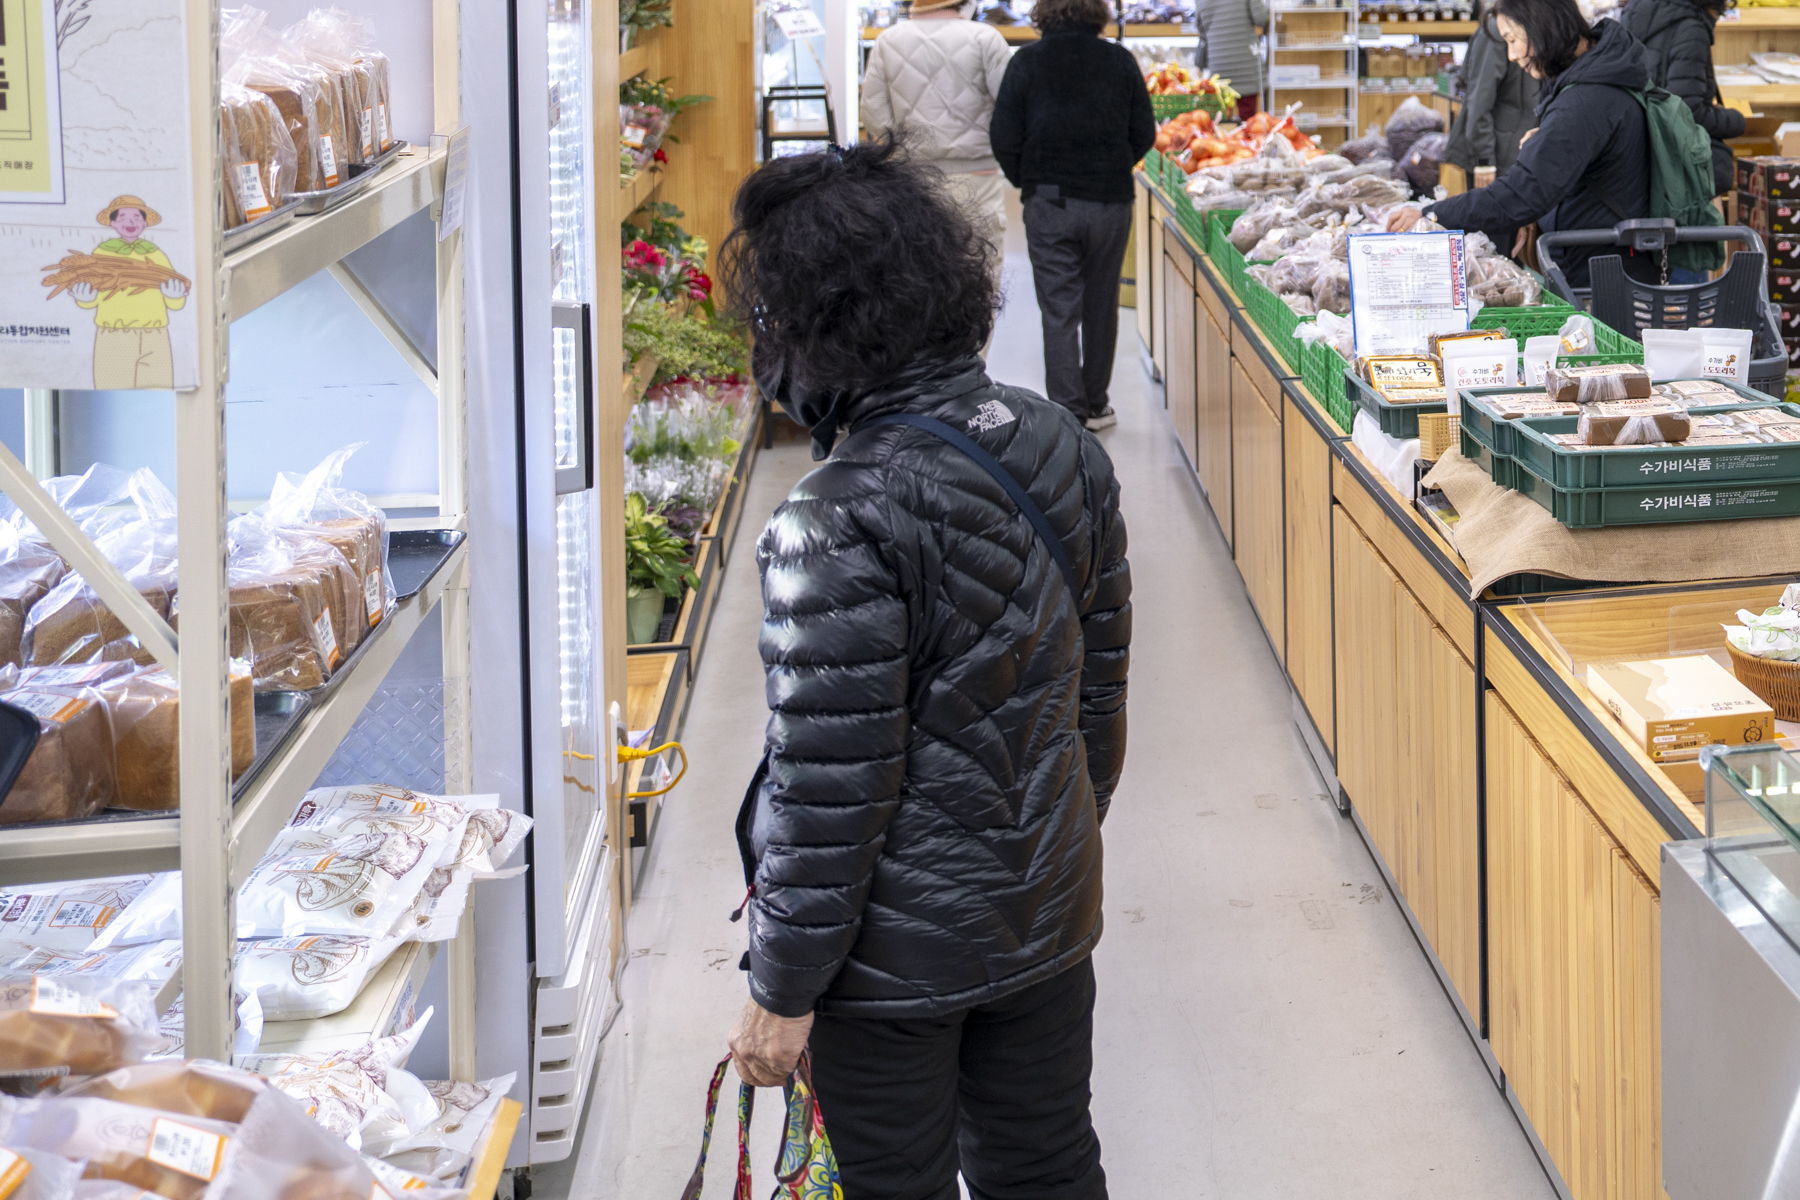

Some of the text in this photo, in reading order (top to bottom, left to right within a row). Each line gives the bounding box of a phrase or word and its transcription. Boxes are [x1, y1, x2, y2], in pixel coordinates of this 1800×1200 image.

[1474, 376, 1505, 385] 도토리묵
[977, 400, 995, 413] THE
[967, 410, 999, 428] NORTH
[980, 418, 1002, 433] FACE
[1639, 457, 1712, 474] 수가비식품
[1639, 493, 1712, 511] 수가비식품
